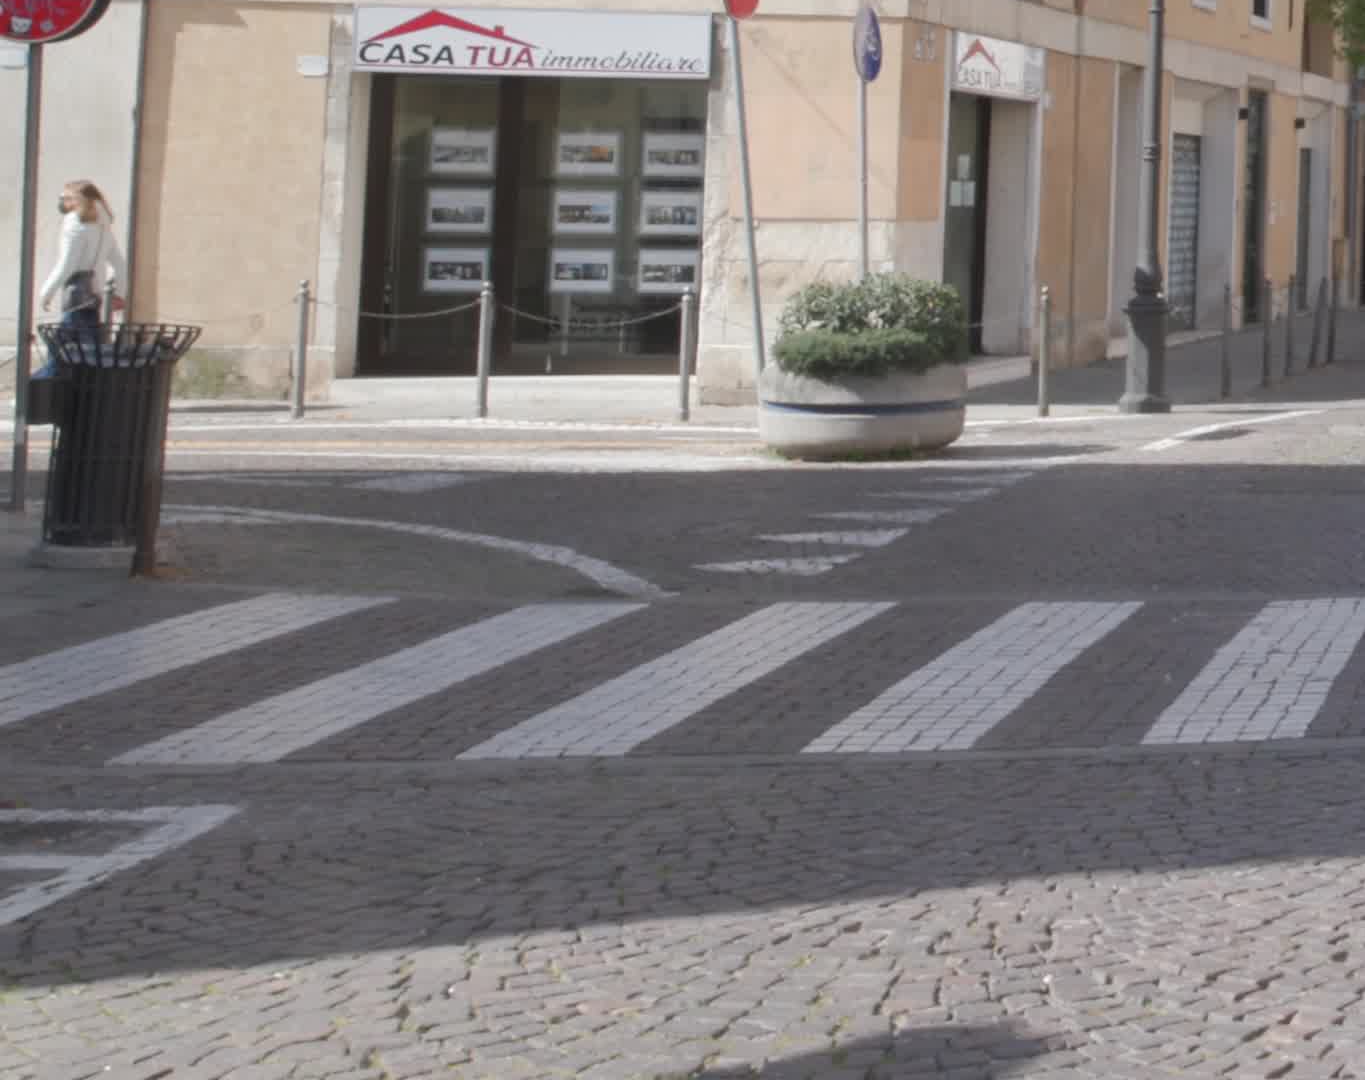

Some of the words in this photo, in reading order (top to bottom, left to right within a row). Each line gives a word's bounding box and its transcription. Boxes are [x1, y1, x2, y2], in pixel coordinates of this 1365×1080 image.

[359, 43, 454, 65] CASA
[466, 46, 534, 67] TUA
[540, 48, 703, 70] immobiliare
